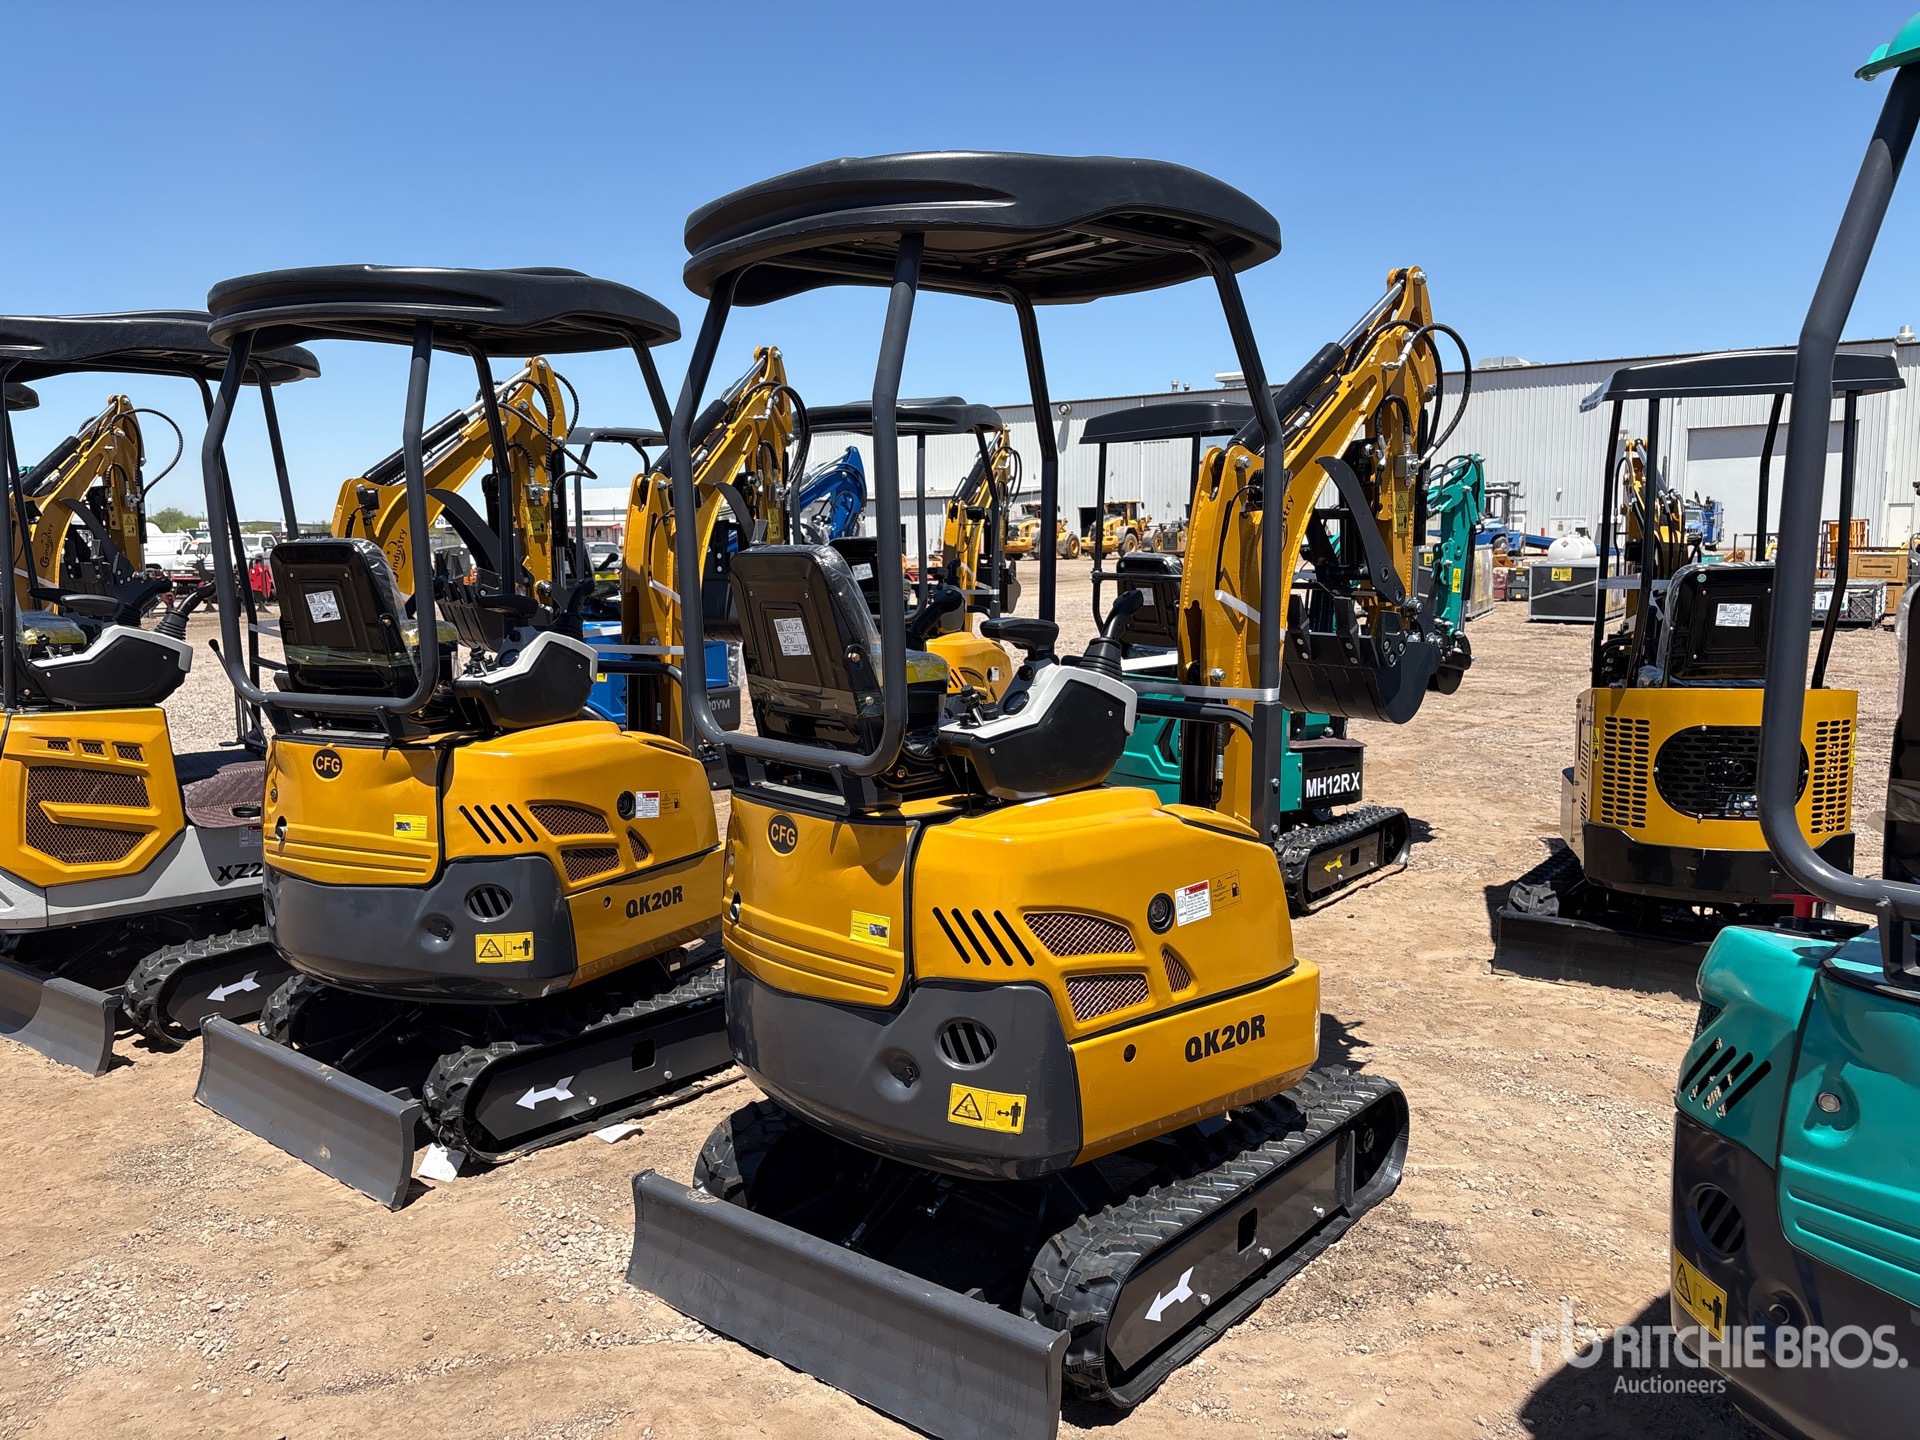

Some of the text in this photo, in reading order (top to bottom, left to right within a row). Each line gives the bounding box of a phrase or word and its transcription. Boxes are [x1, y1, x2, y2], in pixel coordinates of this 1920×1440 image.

[315, 755, 341, 773] CFG
[1305, 771, 1361, 799] MH12RX
[770, 822, 797, 847] CFG
[625, 884, 684, 919] QK20R
[1184, 1013, 1266, 1063] QK20R
